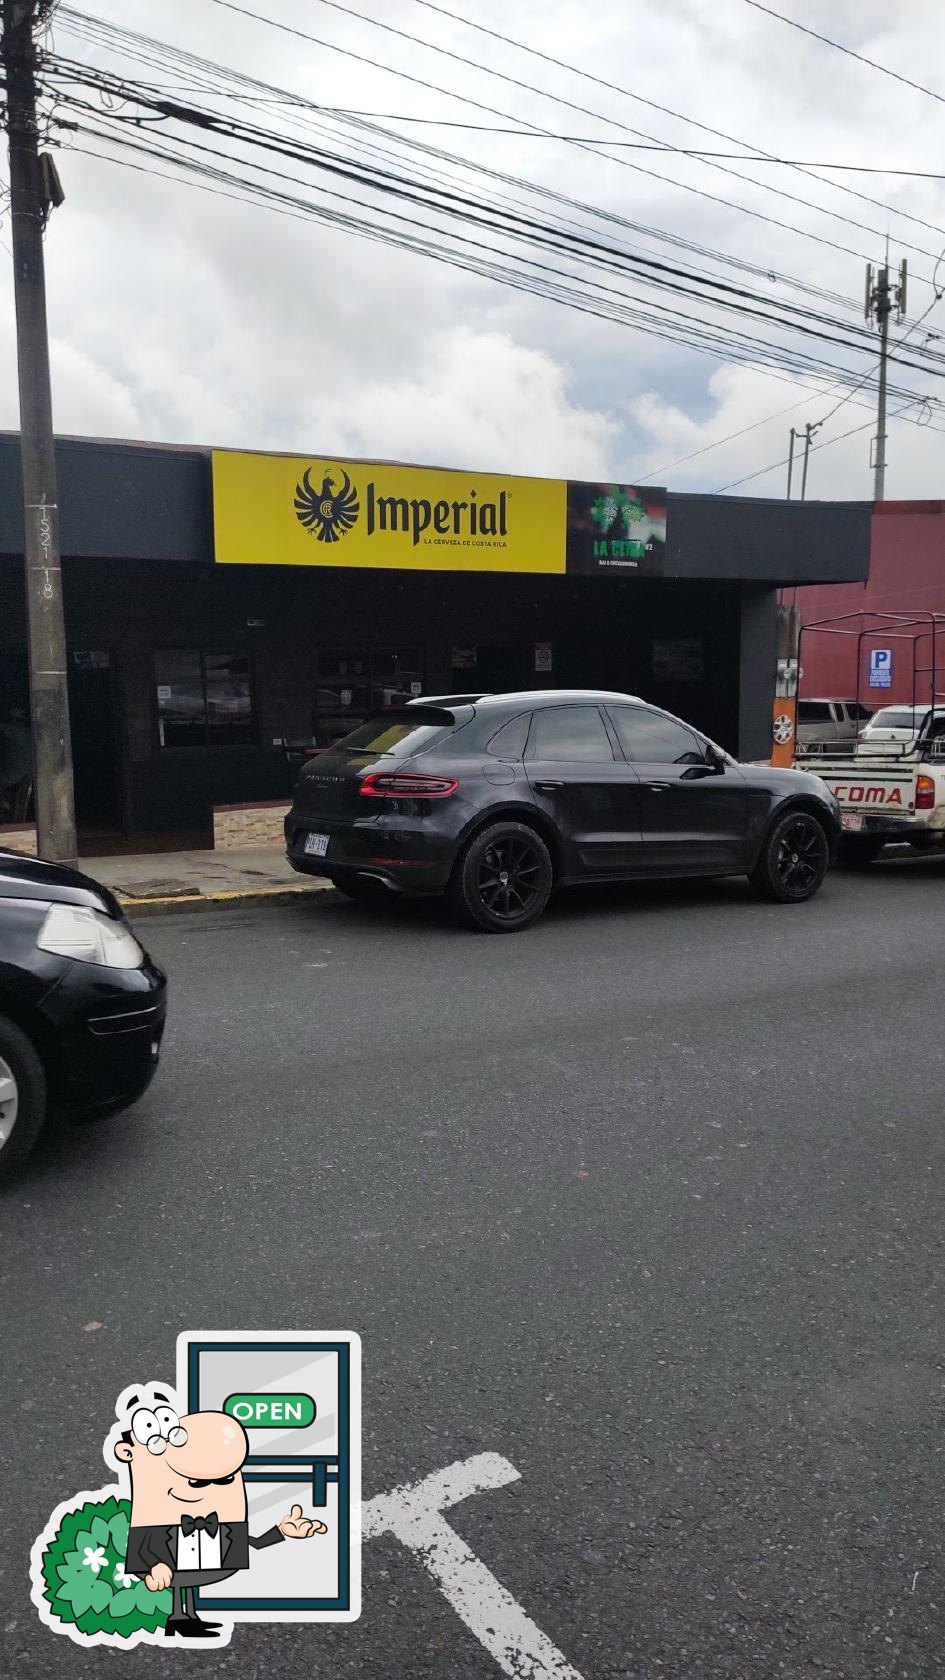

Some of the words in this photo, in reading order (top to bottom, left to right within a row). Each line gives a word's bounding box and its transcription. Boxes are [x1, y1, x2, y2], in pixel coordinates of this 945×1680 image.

[367, 482, 507, 546] Imperial
[593, 540, 608, 556] LA
[875, 652, 887, 668] P
